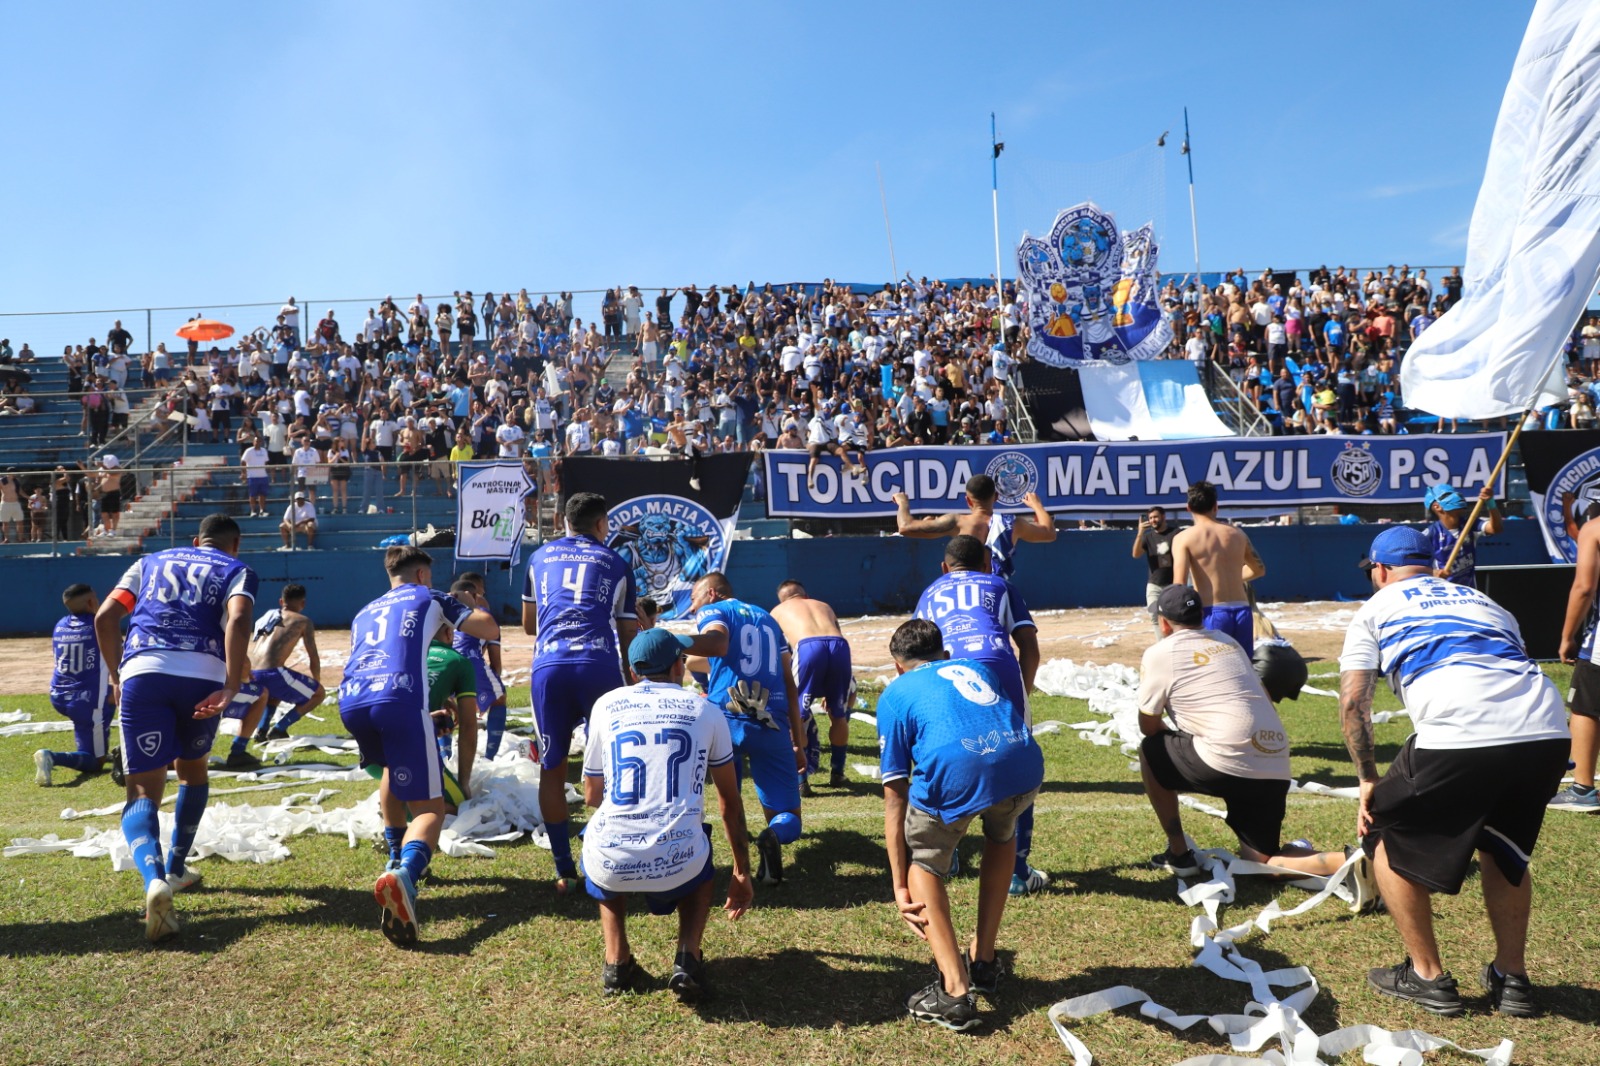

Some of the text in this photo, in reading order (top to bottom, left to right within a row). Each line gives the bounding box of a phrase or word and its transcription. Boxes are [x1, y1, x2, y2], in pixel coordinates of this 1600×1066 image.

[777, 446, 1323, 504] TORCIDA MÁFIA AZUL
[1343, 462, 1370, 485] PSA
[1389, 447, 1493, 489] P.S.A
[646, 501, 698, 523] MAFIA
[177, 552, 211, 561] BANCA
[561, 553, 596, 561] BANCA
[156, 560, 212, 607] 59
[562, 564, 588, 604] 4
[598, 578, 612, 604] WGS
[934, 584, 981, 618] 50
[364, 606, 392, 646] 3
[402, 610, 418, 638] WGS
[57, 642, 84, 674] 20
[86, 647, 96, 670] WGS
[740, 624, 778, 677] 91
[936, 664, 1000, 707] 8
[610, 703, 650, 714] ALIANÇA
[610, 728, 692, 806] 67
[692, 749, 707, 796] WGS
[621, 832, 648, 845] PFA
[654, 858, 670, 867] Du
